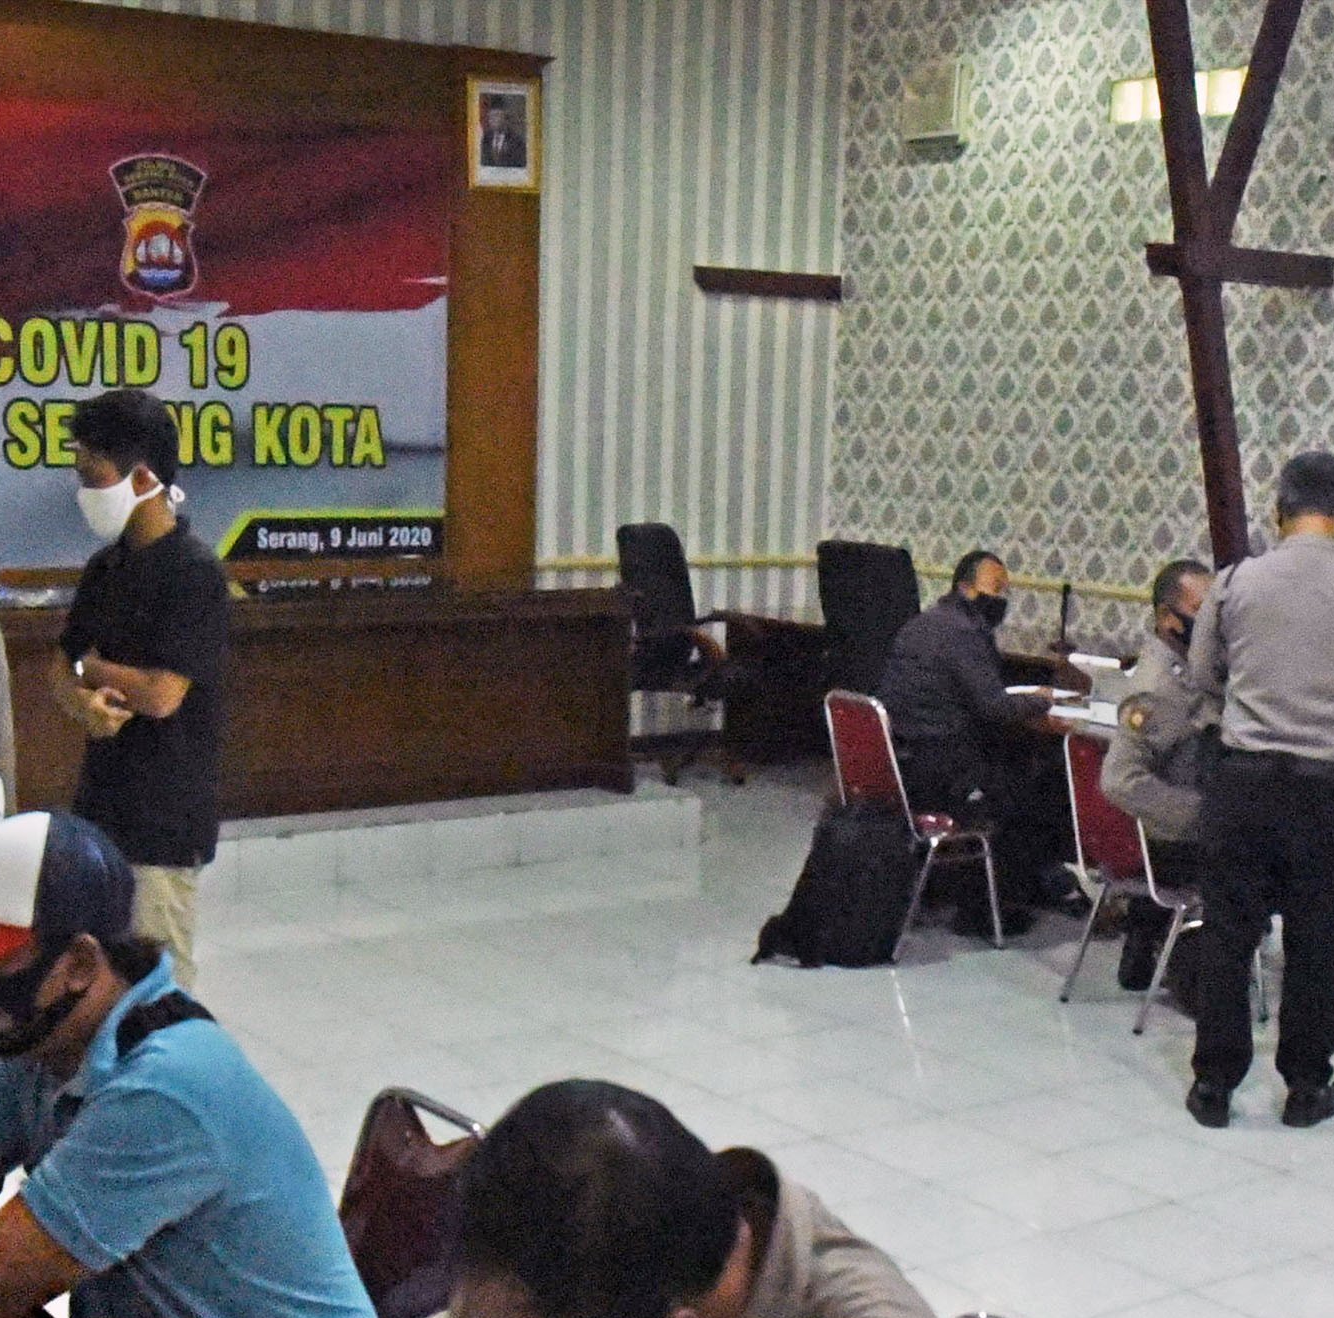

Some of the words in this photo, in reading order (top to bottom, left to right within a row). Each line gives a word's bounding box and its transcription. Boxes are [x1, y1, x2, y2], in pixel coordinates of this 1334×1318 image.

[179, 321, 251, 390] 19
[3, 397, 234, 469] SENG
[252, 402, 386, 469] KOTA
[256, 527, 325, 552] Serang,
[329, 526, 342, 548] 9
[346, 526, 384, 548] Juni
[388, 526, 432, 548] 2020
